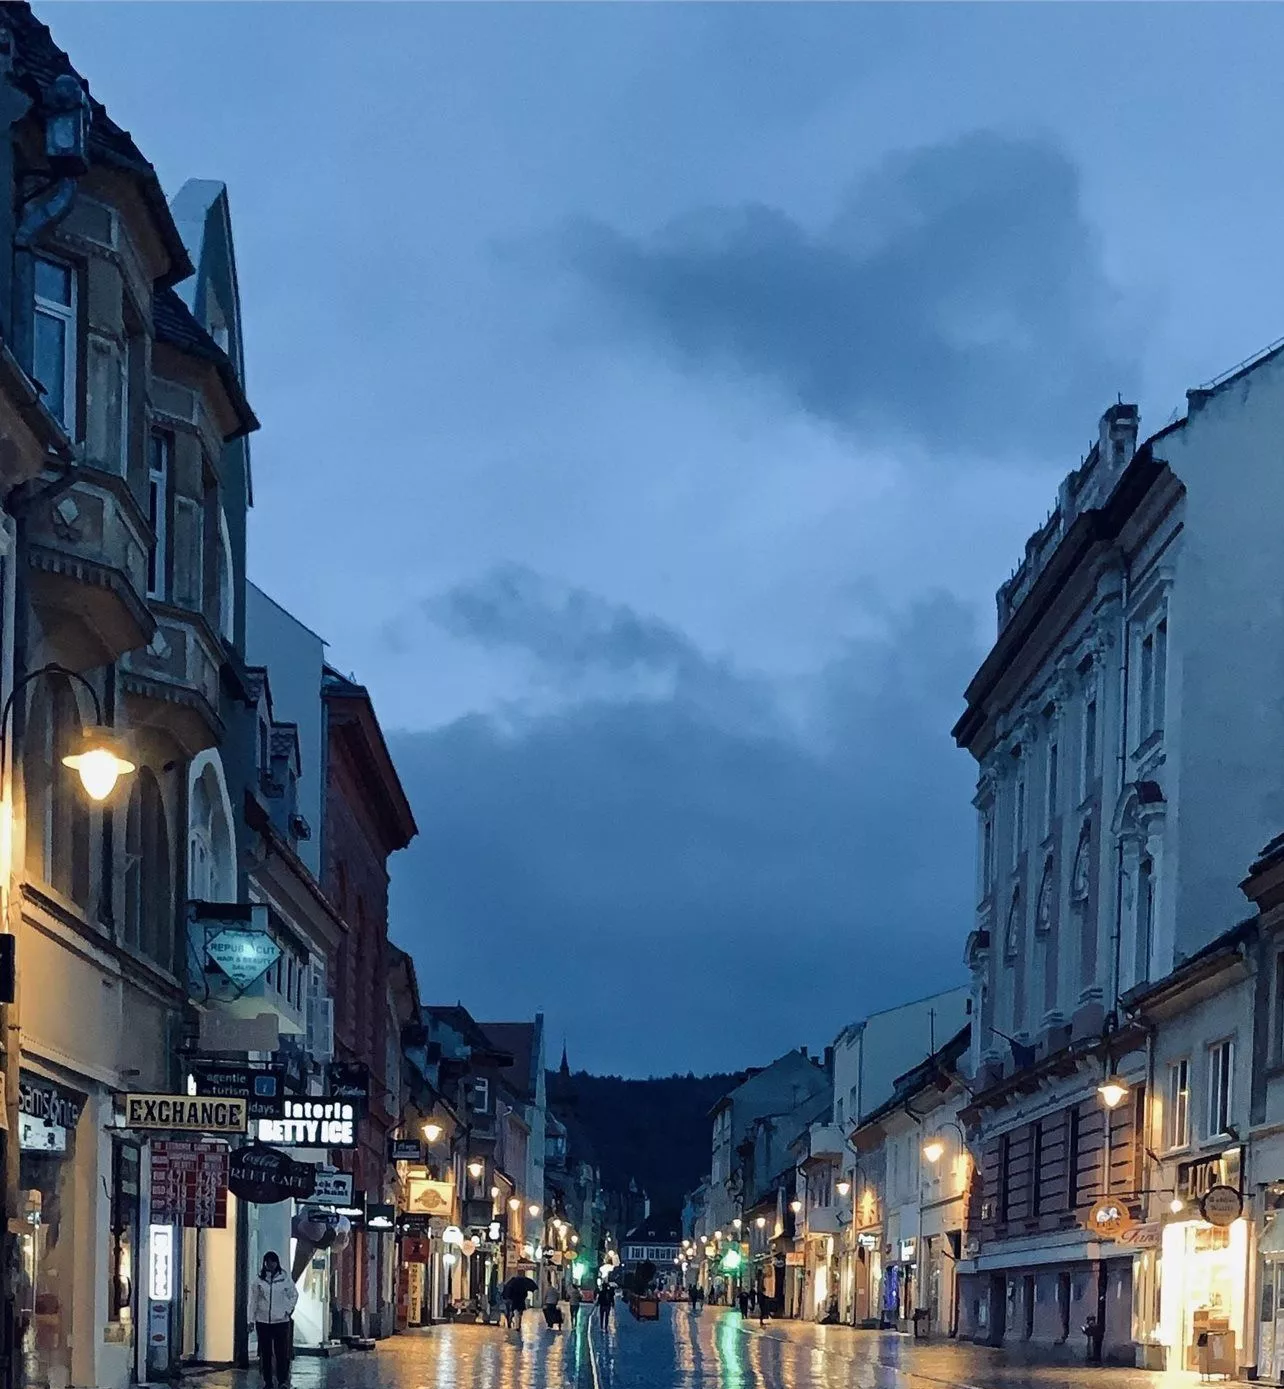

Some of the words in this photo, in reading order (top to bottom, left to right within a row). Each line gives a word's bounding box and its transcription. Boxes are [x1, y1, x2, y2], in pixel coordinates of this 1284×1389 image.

[211, 943, 275, 955] REPUBCUT
[129, 1099, 242, 1126] EXCHANGE
[258, 1119, 319, 1143] BETTY
[321, 1120, 353, 1144] ICE
[316, 1188, 348, 1196] phant
